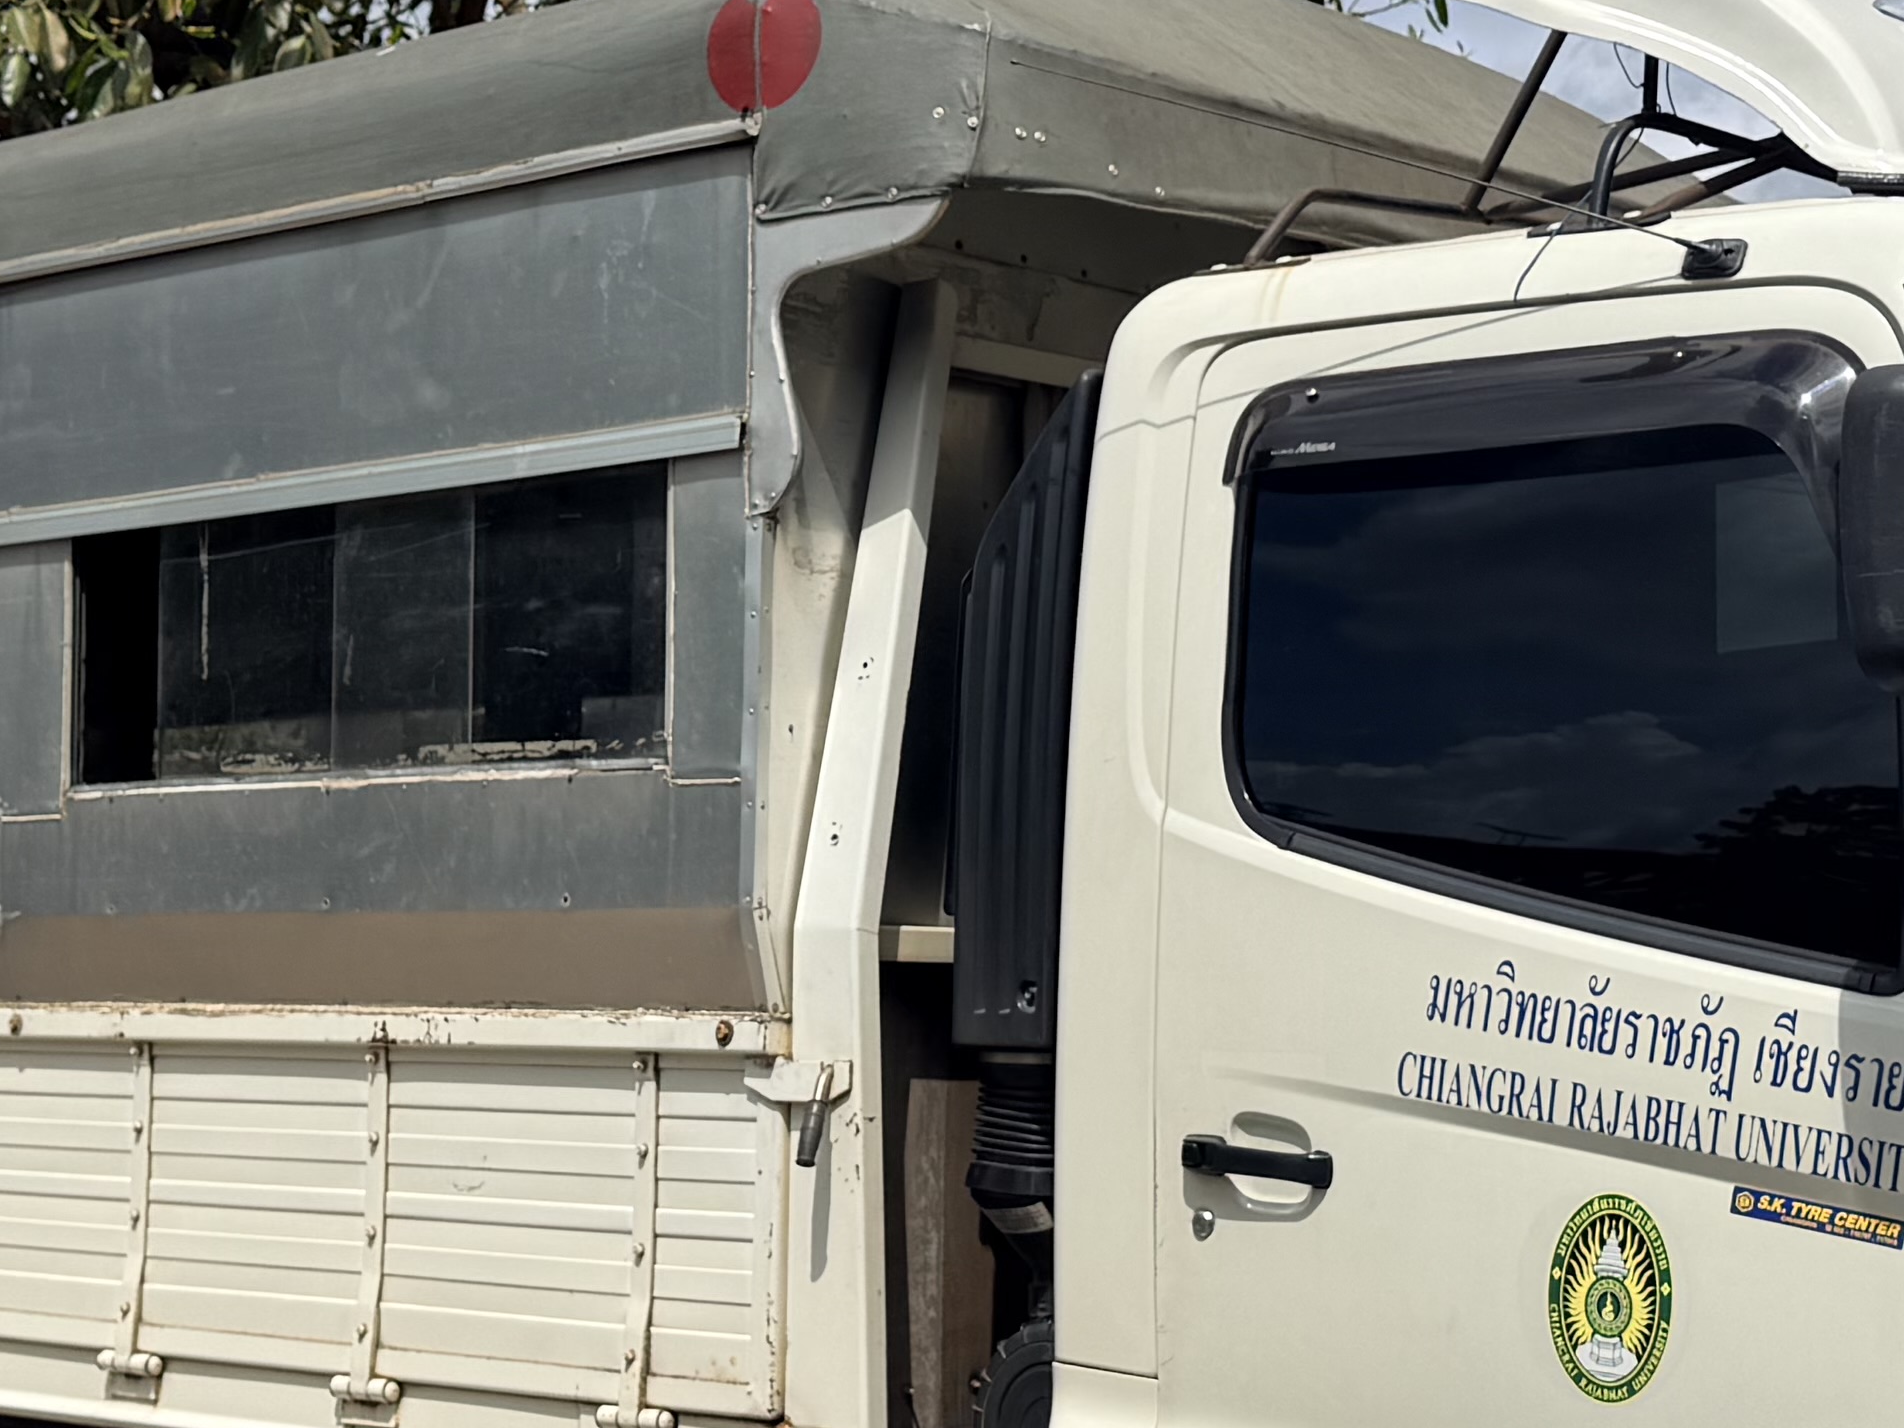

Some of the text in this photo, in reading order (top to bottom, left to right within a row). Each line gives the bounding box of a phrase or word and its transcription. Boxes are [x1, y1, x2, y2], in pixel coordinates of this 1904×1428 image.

[1425, 959, 1741, 1102] มหาวิทยาลัยราชภัฏ
[1397, 1050, 1559, 1125] CHIANGRAI
[1567, 1082, 1728, 1158] RAJABHAT
[1757, 1194, 1787, 1214] S.K.
[1790, 1201, 1834, 1223] TYRE
[1834, 1211, 1902, 1238] CENTER
